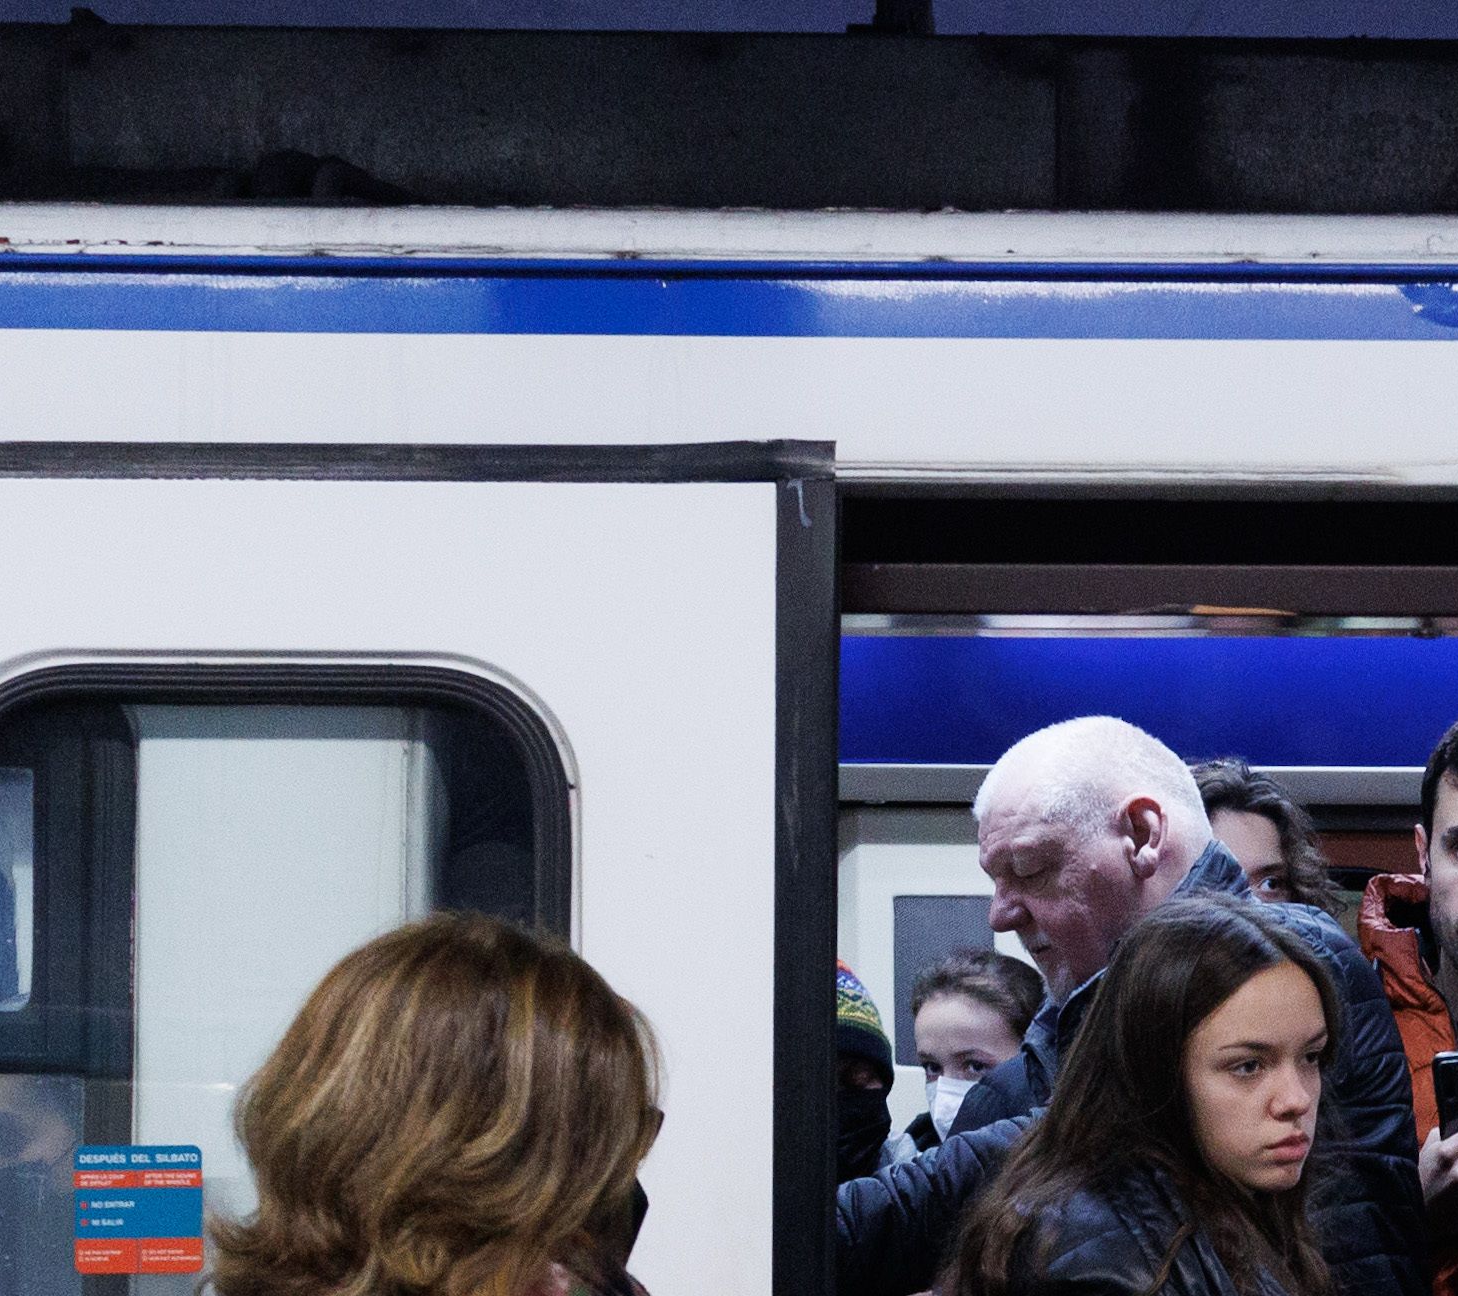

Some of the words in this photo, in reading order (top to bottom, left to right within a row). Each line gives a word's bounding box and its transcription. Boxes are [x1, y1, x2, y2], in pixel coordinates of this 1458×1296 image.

[79, 1152, 126, 1164] DESPUÉS
[131, 1154, 151, 1163] DEL
[154, 1153, 198, 1163] SILBATO
